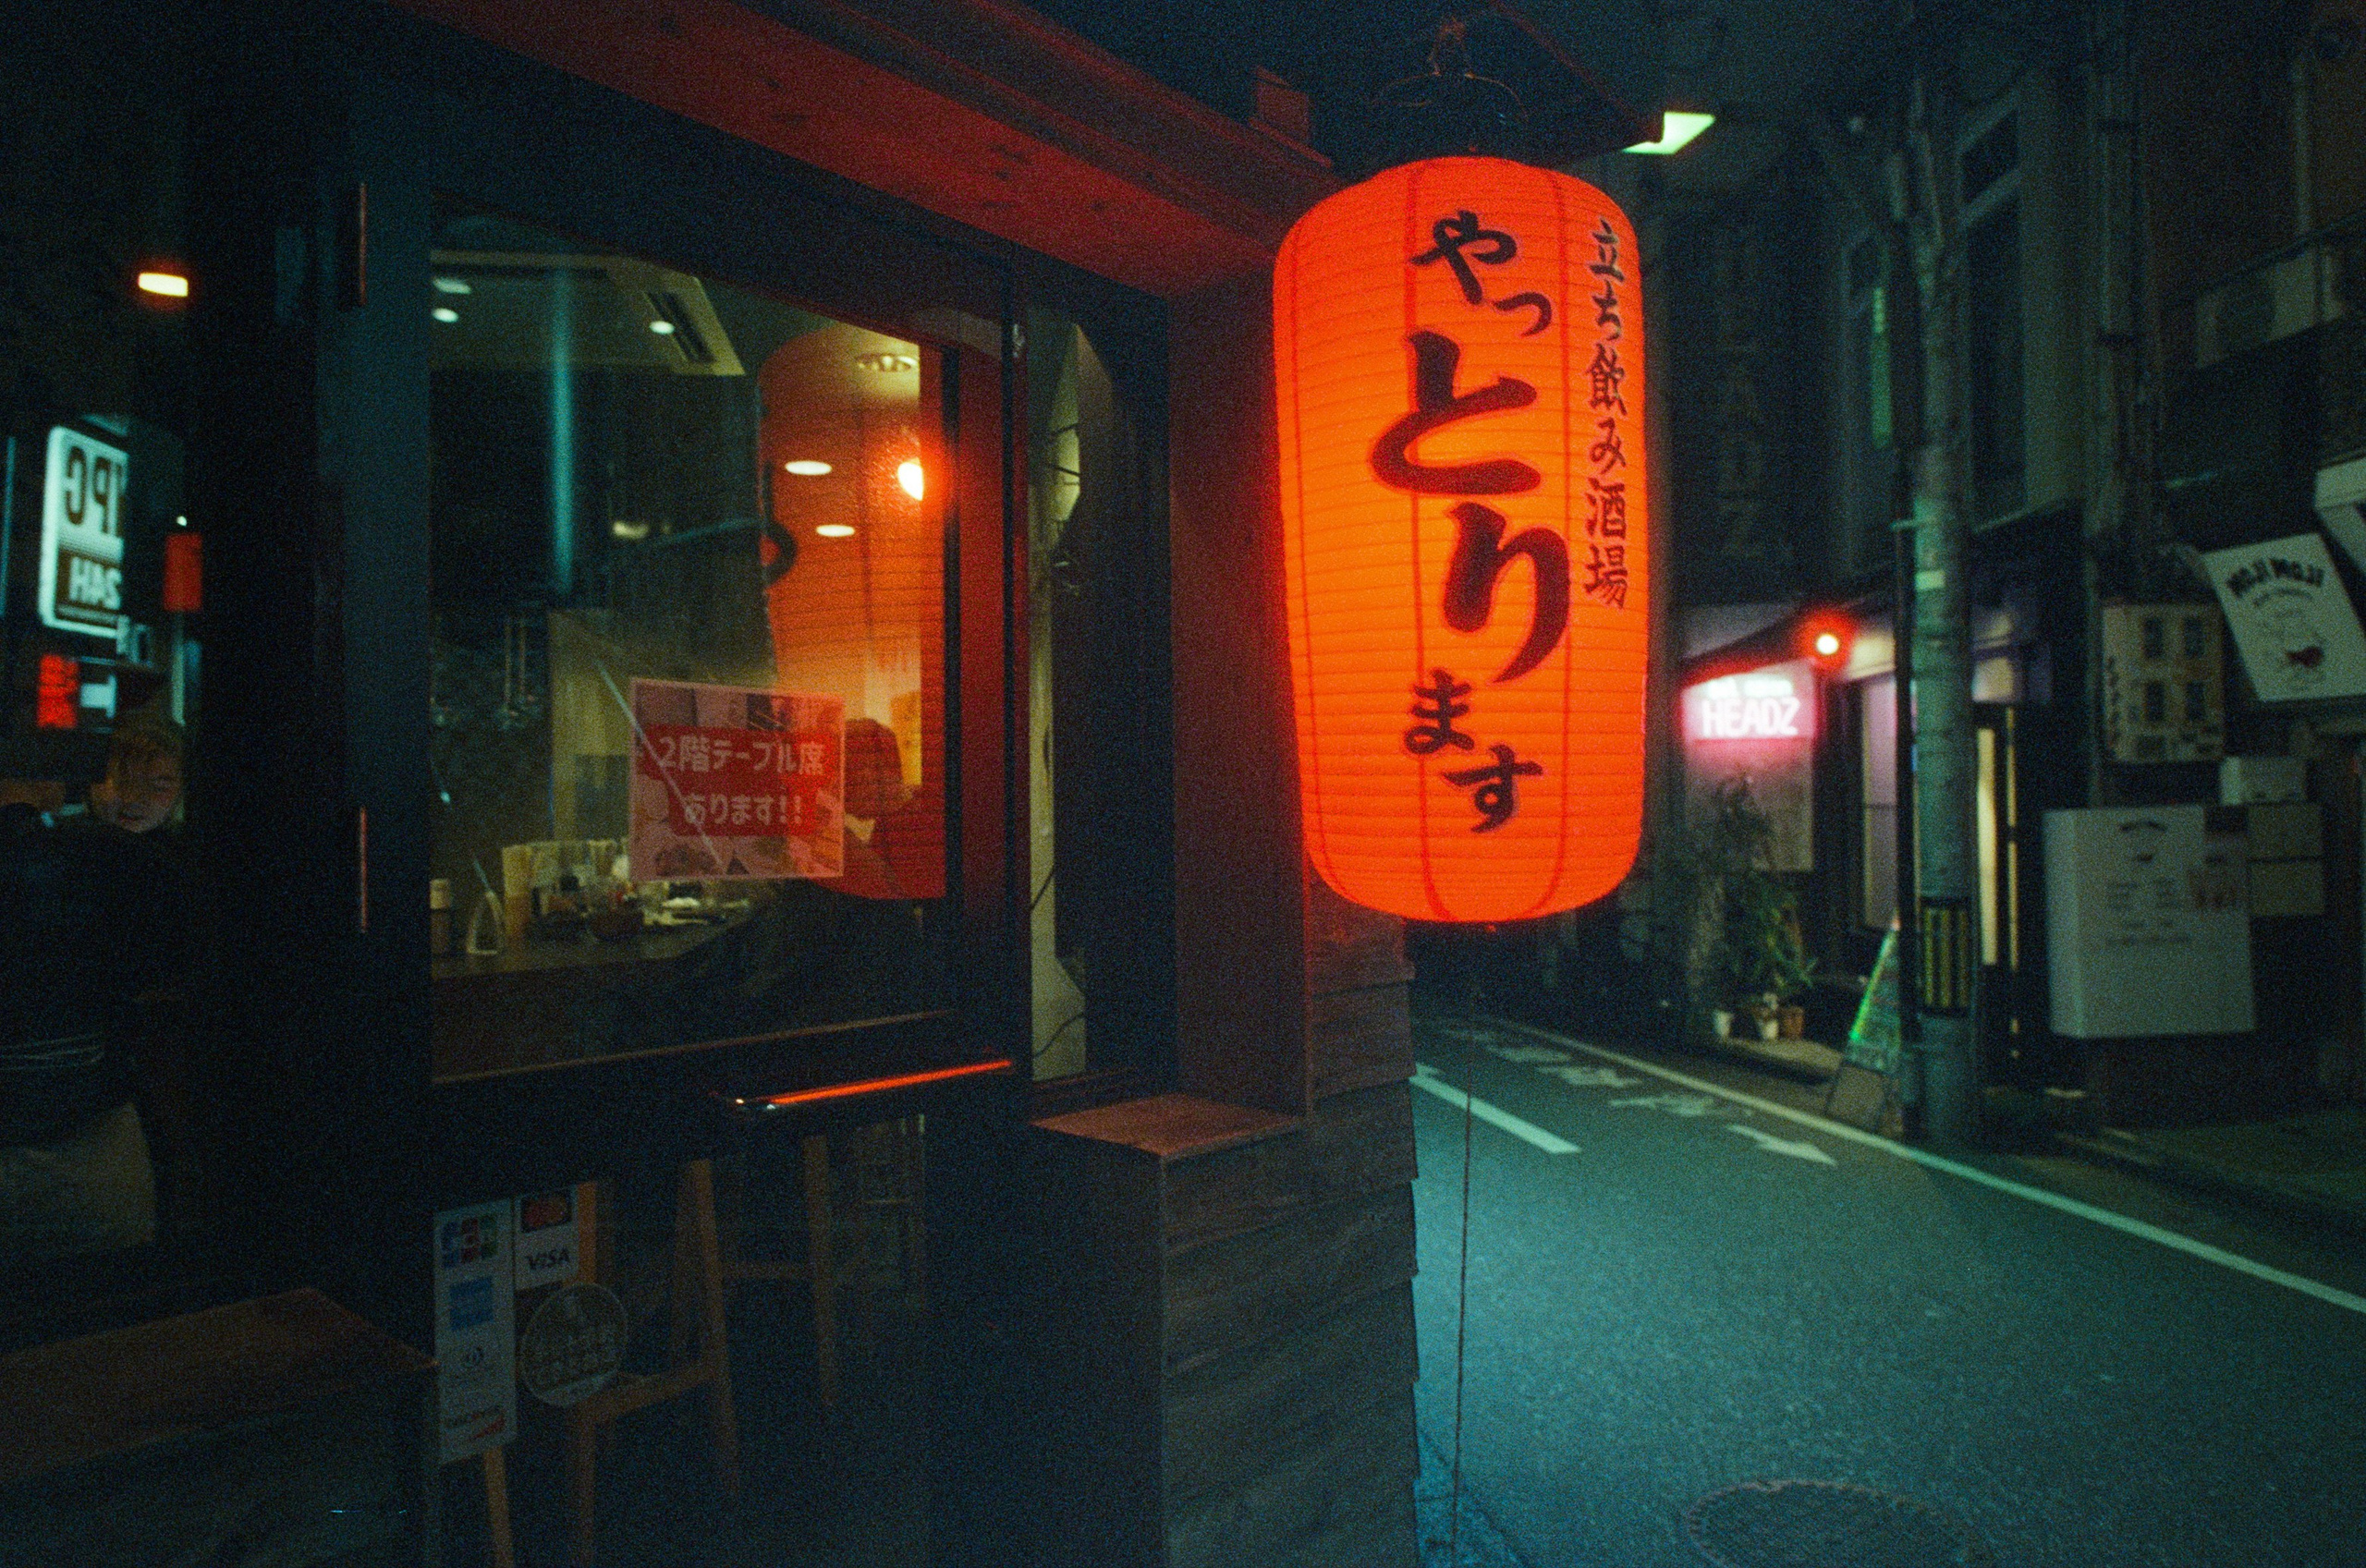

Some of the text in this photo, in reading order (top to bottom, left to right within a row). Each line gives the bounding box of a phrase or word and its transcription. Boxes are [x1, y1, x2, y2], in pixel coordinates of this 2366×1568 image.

[1585, 220, 1628, 607] 立ち飲み酒場
[1370, 209, 1571, 833] やっとります
[1701, 698, 1800, 737] HEADZ
[526, 1248, 569, 1270] VISA
